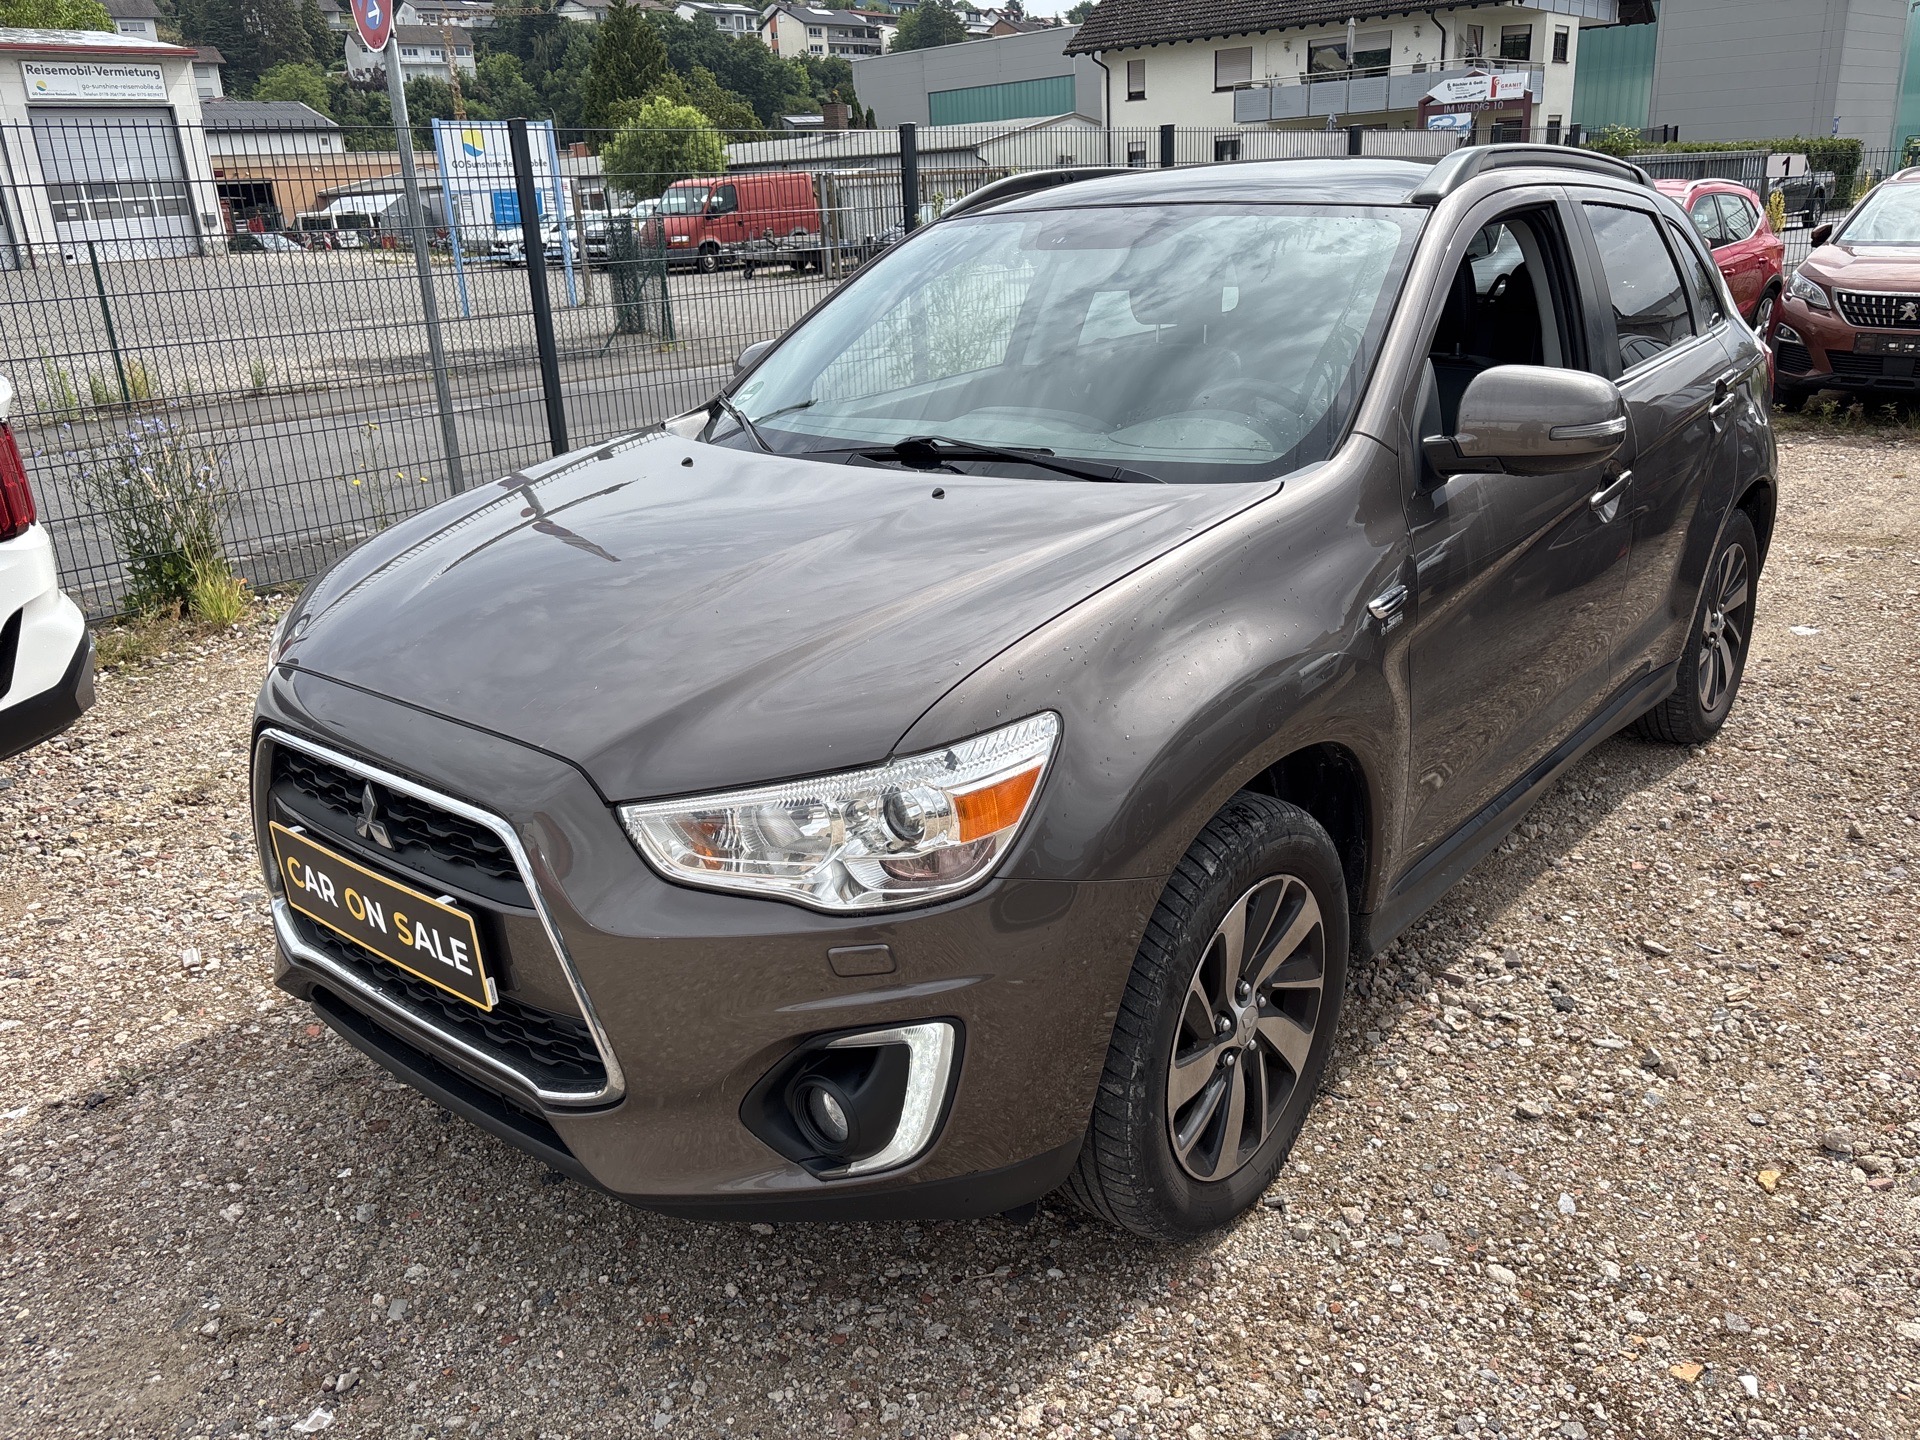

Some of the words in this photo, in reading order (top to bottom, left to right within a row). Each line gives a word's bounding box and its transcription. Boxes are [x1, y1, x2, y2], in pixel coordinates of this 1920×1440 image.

[25, 64, 160, 80] Reisemobil-Vermietung
[1444, 105, 1454, 113] IM
[1494, 101, 1504, 110] 10
[452, 160, 465, 169] GO
[466, 160, 502, 169] Sunshine
[503, 159, 548, 168] Reobile
[1781, 155, 1790, 176] 1
[286, 856, 339, 908] CAR
[344, 887, 387, 934] ON
[393, 911, 473, 976] SALE
